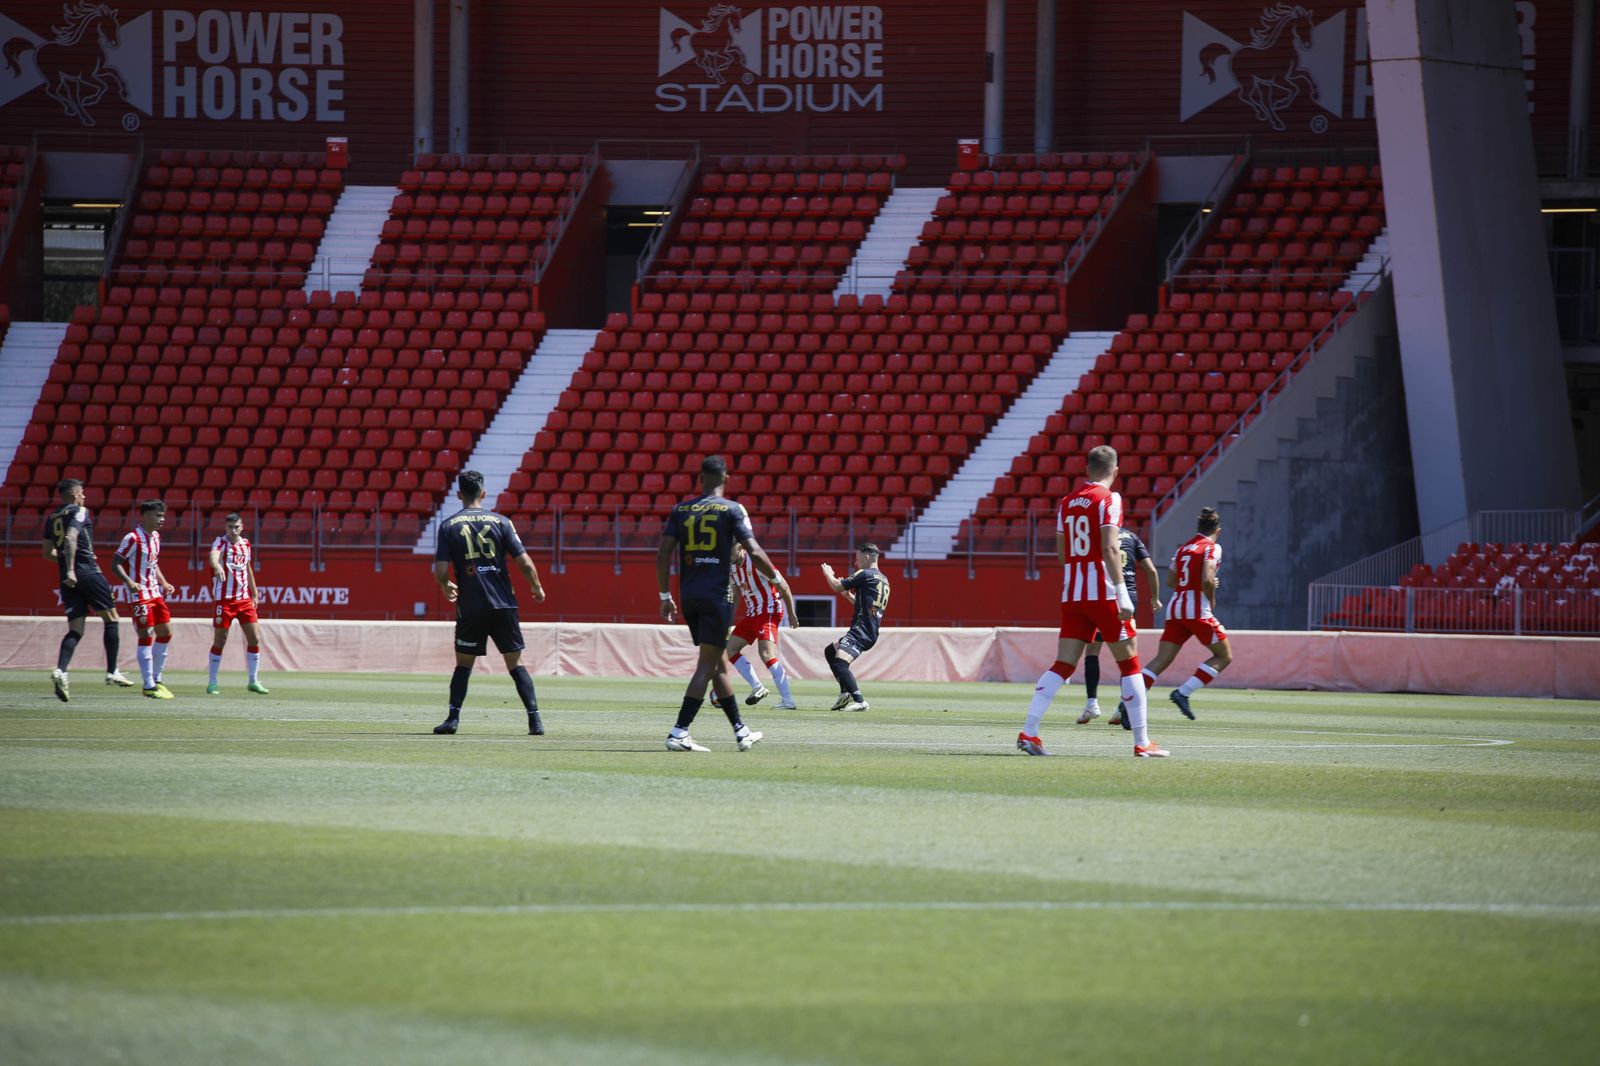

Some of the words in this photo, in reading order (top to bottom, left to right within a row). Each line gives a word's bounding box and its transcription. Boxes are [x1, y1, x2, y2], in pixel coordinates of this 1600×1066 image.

[163, 10, 345, 65] POWER
[768, 6, 883, 41] POWER
[768, 43, 883, 78] HORSE
[163, 66, 346, 121] HORSE
[655, 83, 883, 112] STADIUM
[691, 503, 729, 512] CASTRO
[53, 517, 65, 547] 9
[460, 524, 496, 560] 16
[683, 514, 718, 551] 15
[1064, 515, 1091, 557] 18
[1179, 555, 1191, 587] 3
[134, 604, 149, 617] 23
[216, 604, 223, 616] 6
[257, 586, 349, 605] EVANTE
[872, 581, 891, 611] 18
